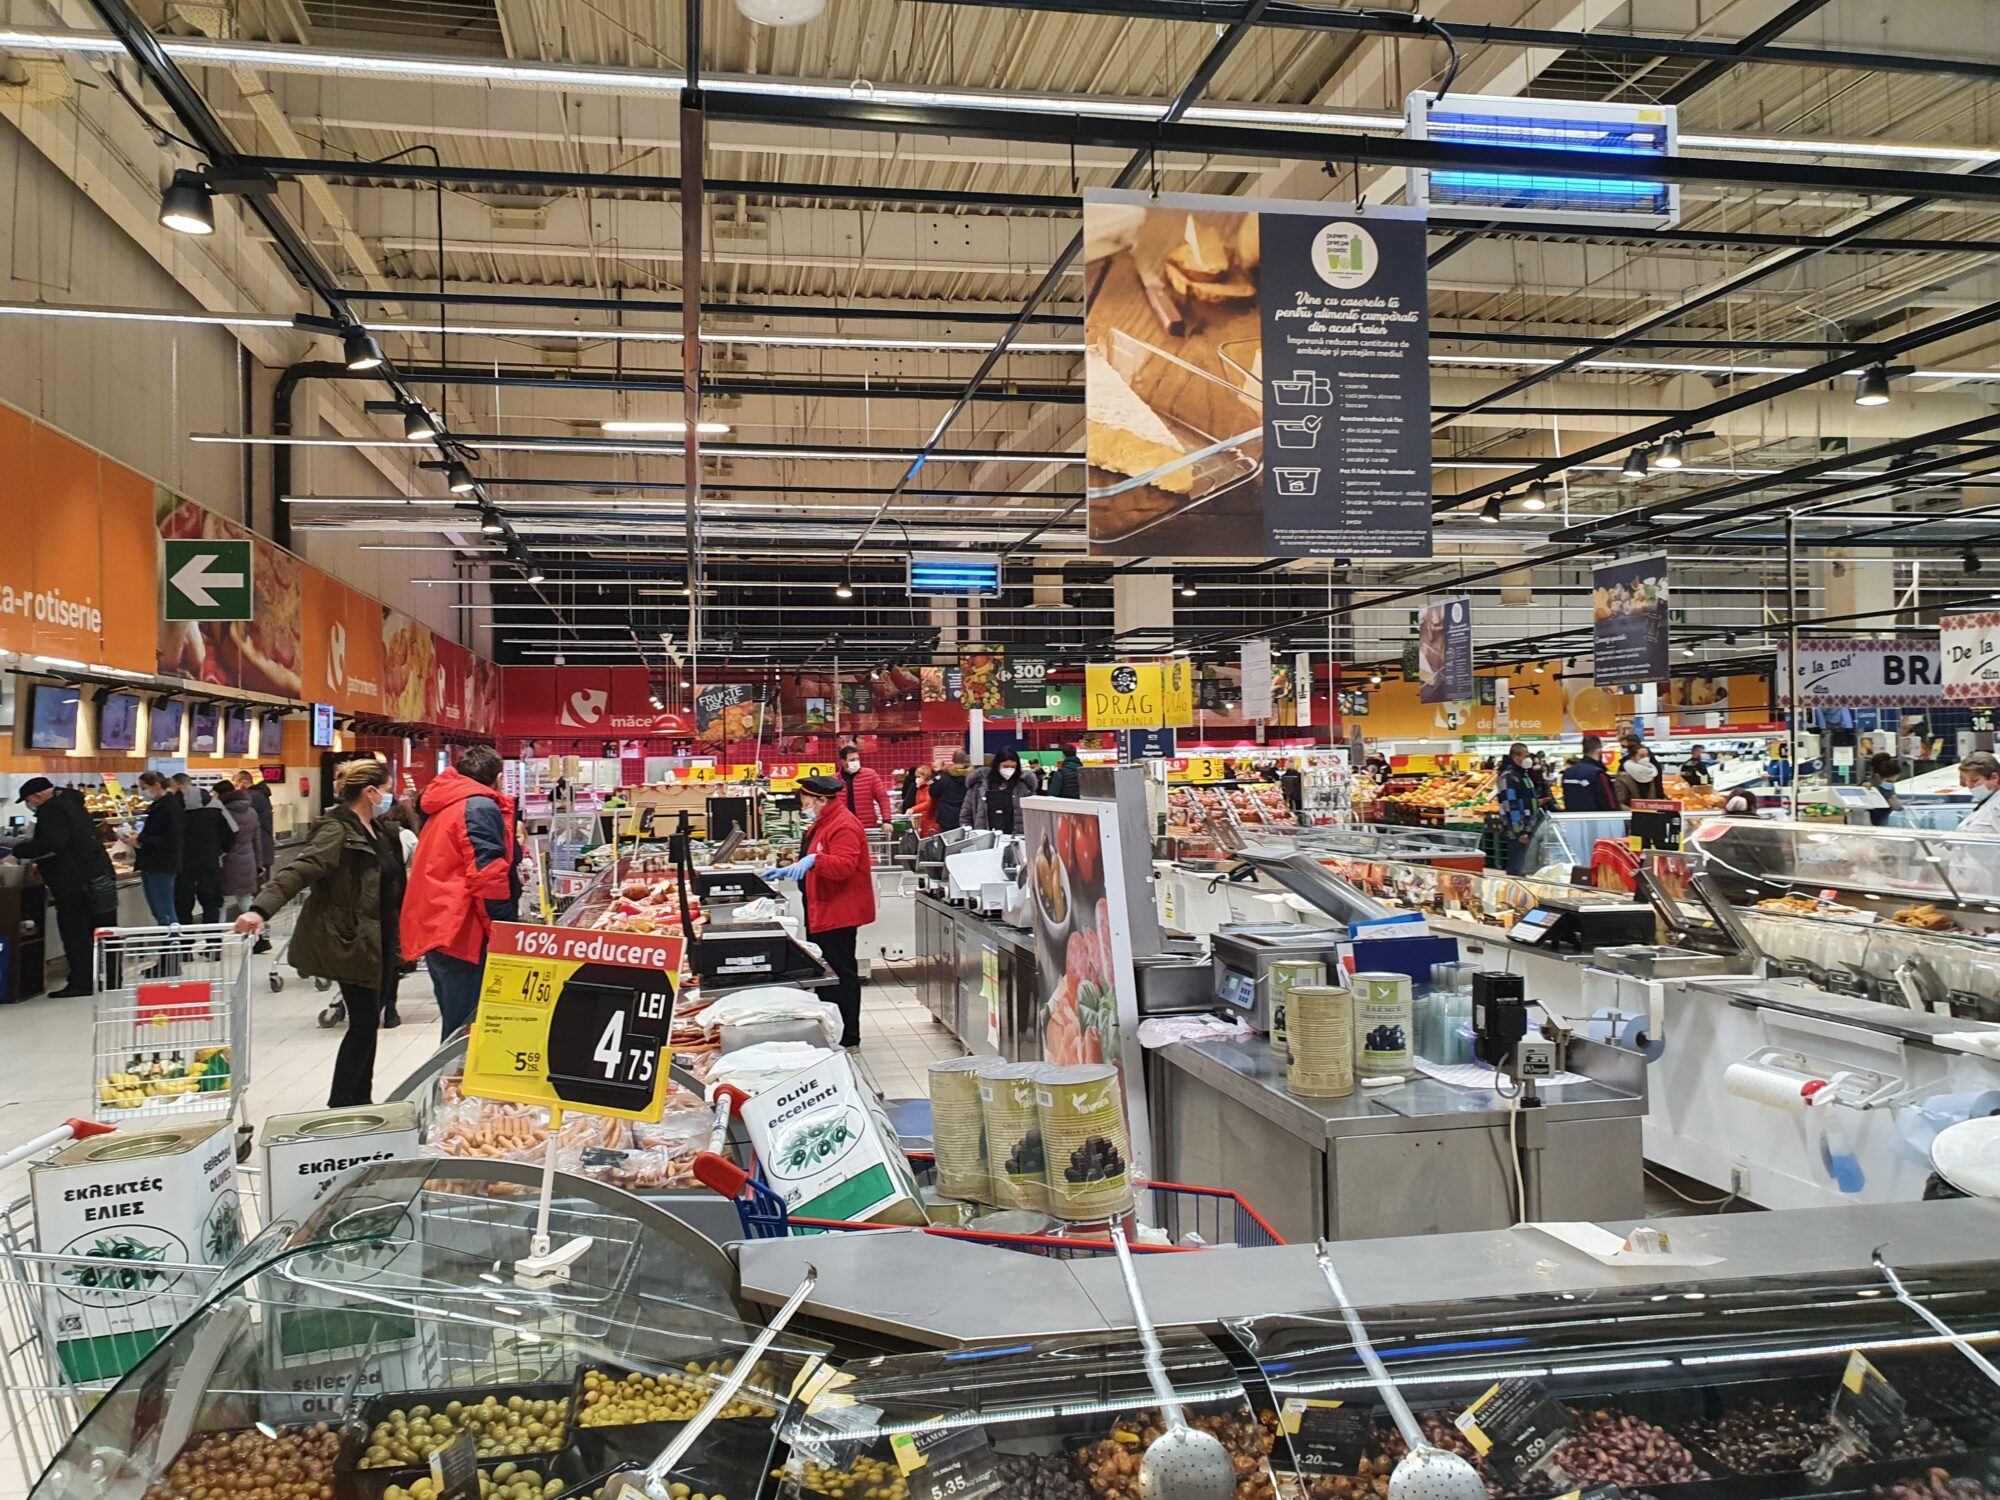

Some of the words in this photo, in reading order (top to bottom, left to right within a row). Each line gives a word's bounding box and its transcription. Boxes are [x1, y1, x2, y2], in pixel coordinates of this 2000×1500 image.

[1295, 291, 1322, 306] Vine
[1325, 298, 1338, 306] cu
[1275, 307, 1312, 321] pentru
[1314, 308, 1361, 320] alimente
[1308, 321, 1327, 332] din
[0, 584, 101, 633] a-rotiserie
[1979, 639, 1993, 655] la
[1013, 665, 1045, 678] 300
[1812, 659, 1824, 674] la
[699, 686, 743, 707] FRUCTE
[1813, 684, 1829, 694] din
[1096, 693, 1153, 715] DRAG
[697, 769, 704, 781] 4
[1203, 760, 1212, 777] 3
[514, 930, 558, 956] 16%
[563, 936, 667, 966] reducere
[536, 984, 551, 1002] 50
[638, 992, 666, 1020] LEI
[593, 1010, 625, 1079] 4
[627, 1049, 655, 1081] 75
[515, 1052, 527, 1071] 5
[528, 1053, 540, 1062] 69
[777, 1079, 819, 1107] OLIVE
[768, 1085, 838, 1128] eccelenti
[203, 1145, 232, 1174] selected
[63, 1177, 163, 1202] εκλεκτές
[209, 1167, 231, 1192] OLIVES
[84, 1201, 144, 1221] ΕΛΙΕΣ
[1514, 1438, 1546, 1468] 3.59
[931, 1475, 966, 1500] 5.35
